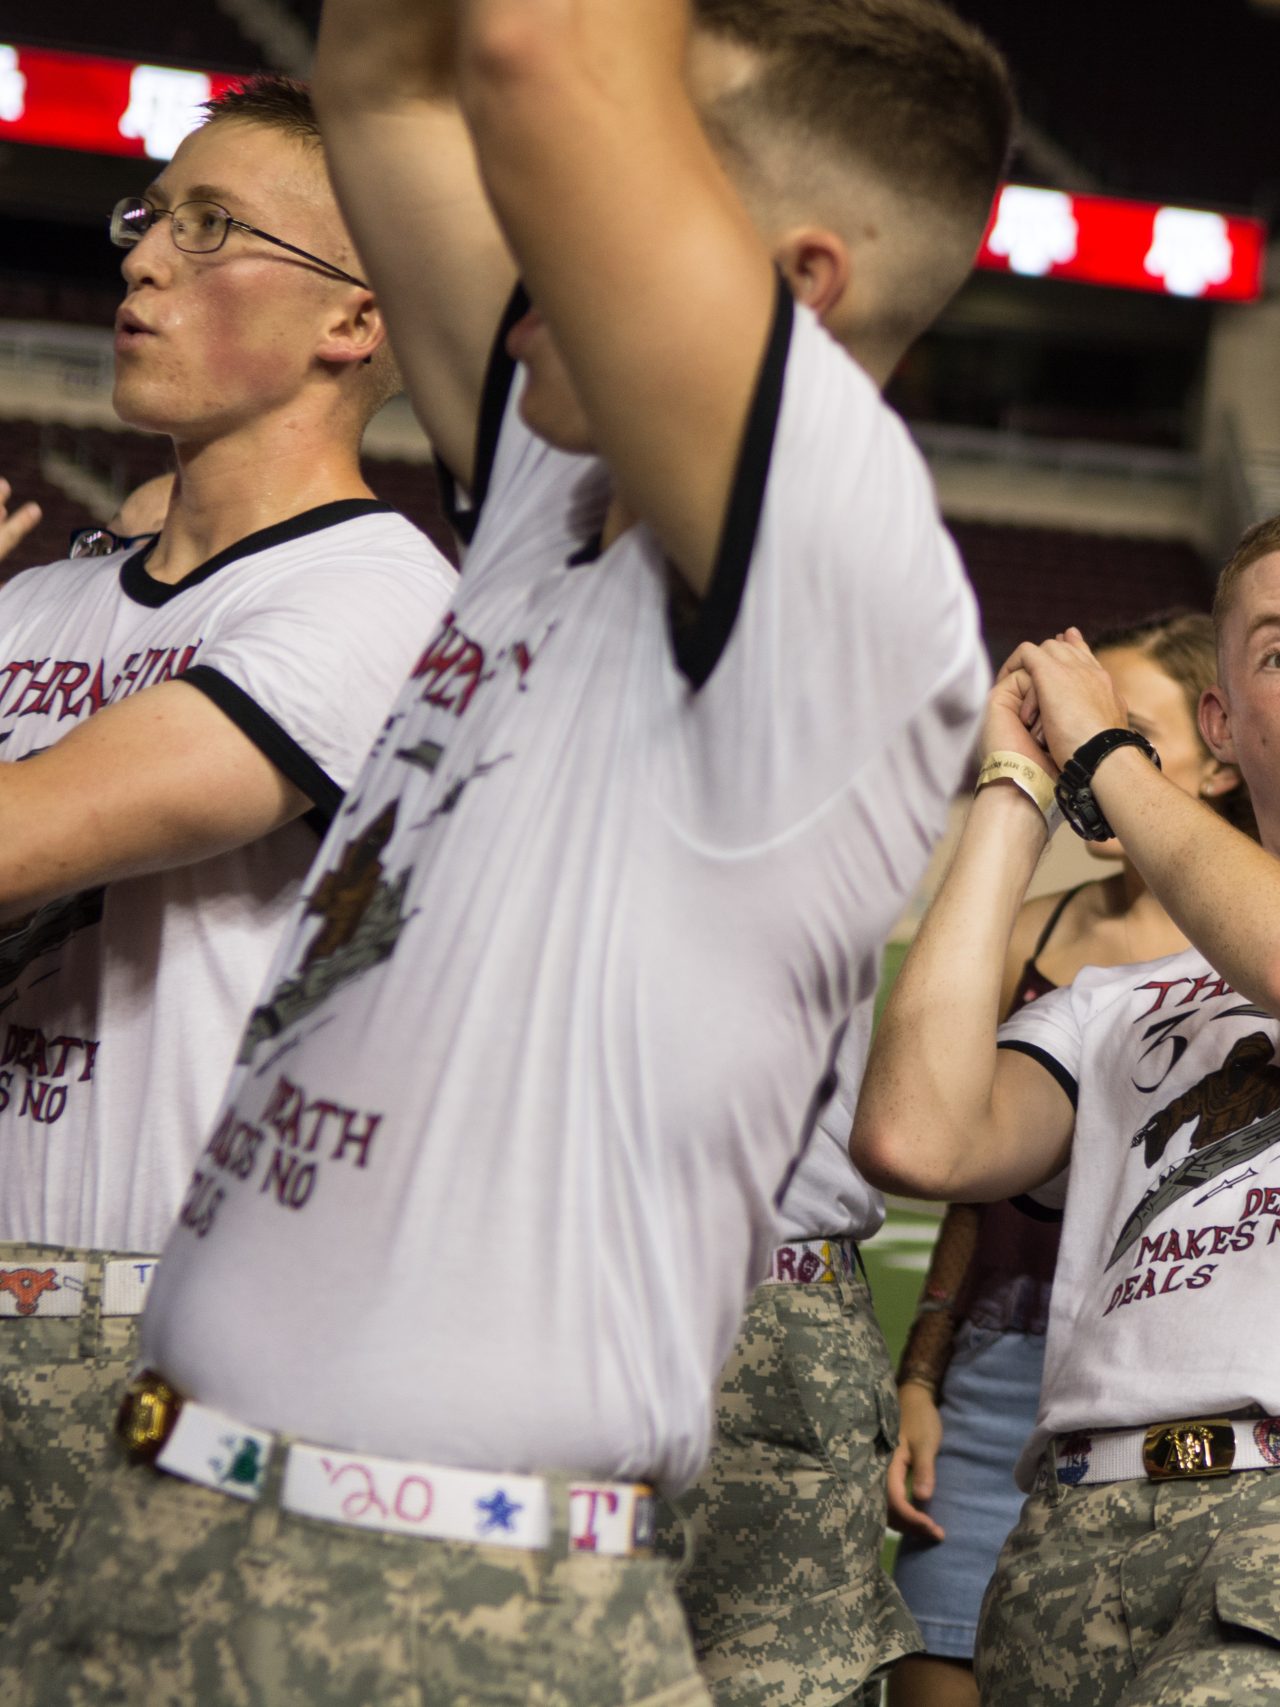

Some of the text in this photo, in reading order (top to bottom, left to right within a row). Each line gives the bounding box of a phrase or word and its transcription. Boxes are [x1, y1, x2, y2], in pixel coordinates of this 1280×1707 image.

[19, 1079, 68, 1124] NO
[259, 1146, 319, 1211] NO
[1134, 1221, 1259, 1269] MAKES
[1102, 1264, 1219, 1317] DEALS
